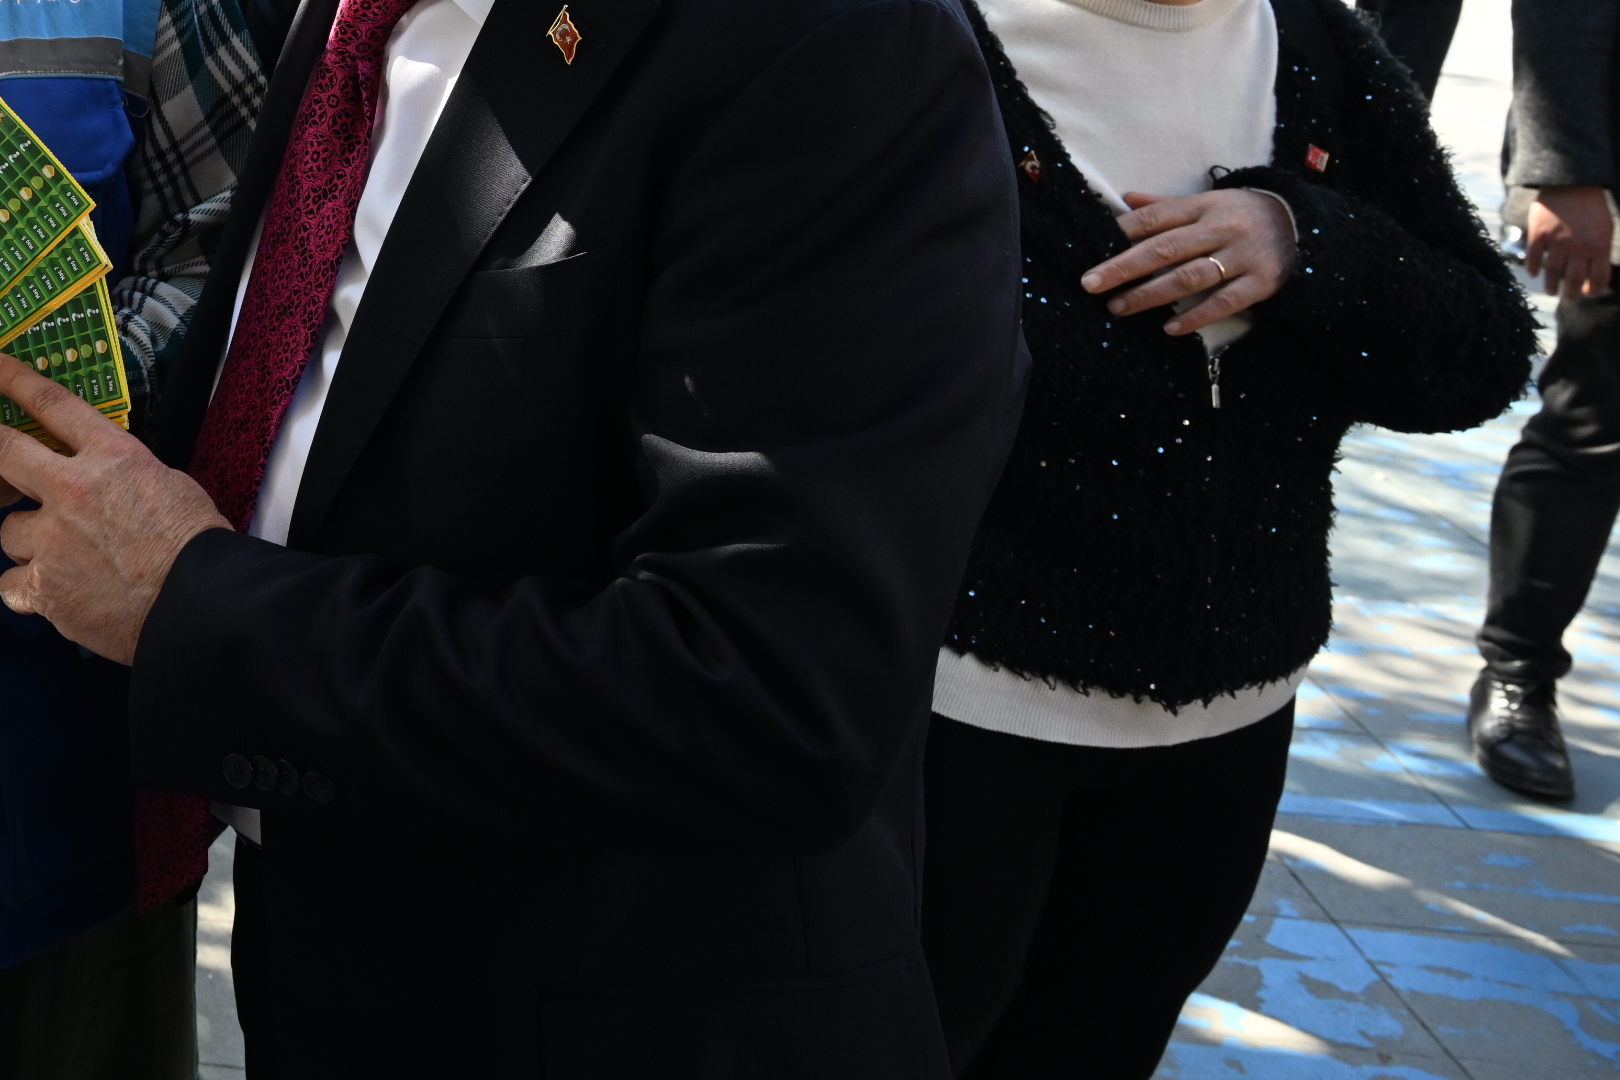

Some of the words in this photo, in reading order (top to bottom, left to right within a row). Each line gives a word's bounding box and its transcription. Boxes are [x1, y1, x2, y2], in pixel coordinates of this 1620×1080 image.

[70, 196, 79, 204] Maç
[59, 207, 67, 215] Maç
[48, 218, 56, 226] Maç
[37, 229, 45, 237] Maç
[25, 240, 34, 248] Maç
[14, 251, 23, 259] Maç
[83, 252, 91, 261] Maç
[3, 261, 11, 270] Maç
[70, 261, 78, 271] Maç
[57, 270, 66, 280] Maç
[45, 279, 53, 289] Maç
[32, 289, 40, 298] Maç
[19, 298, 28, 307] Maç
[7, 307, 15, 317] Maç
